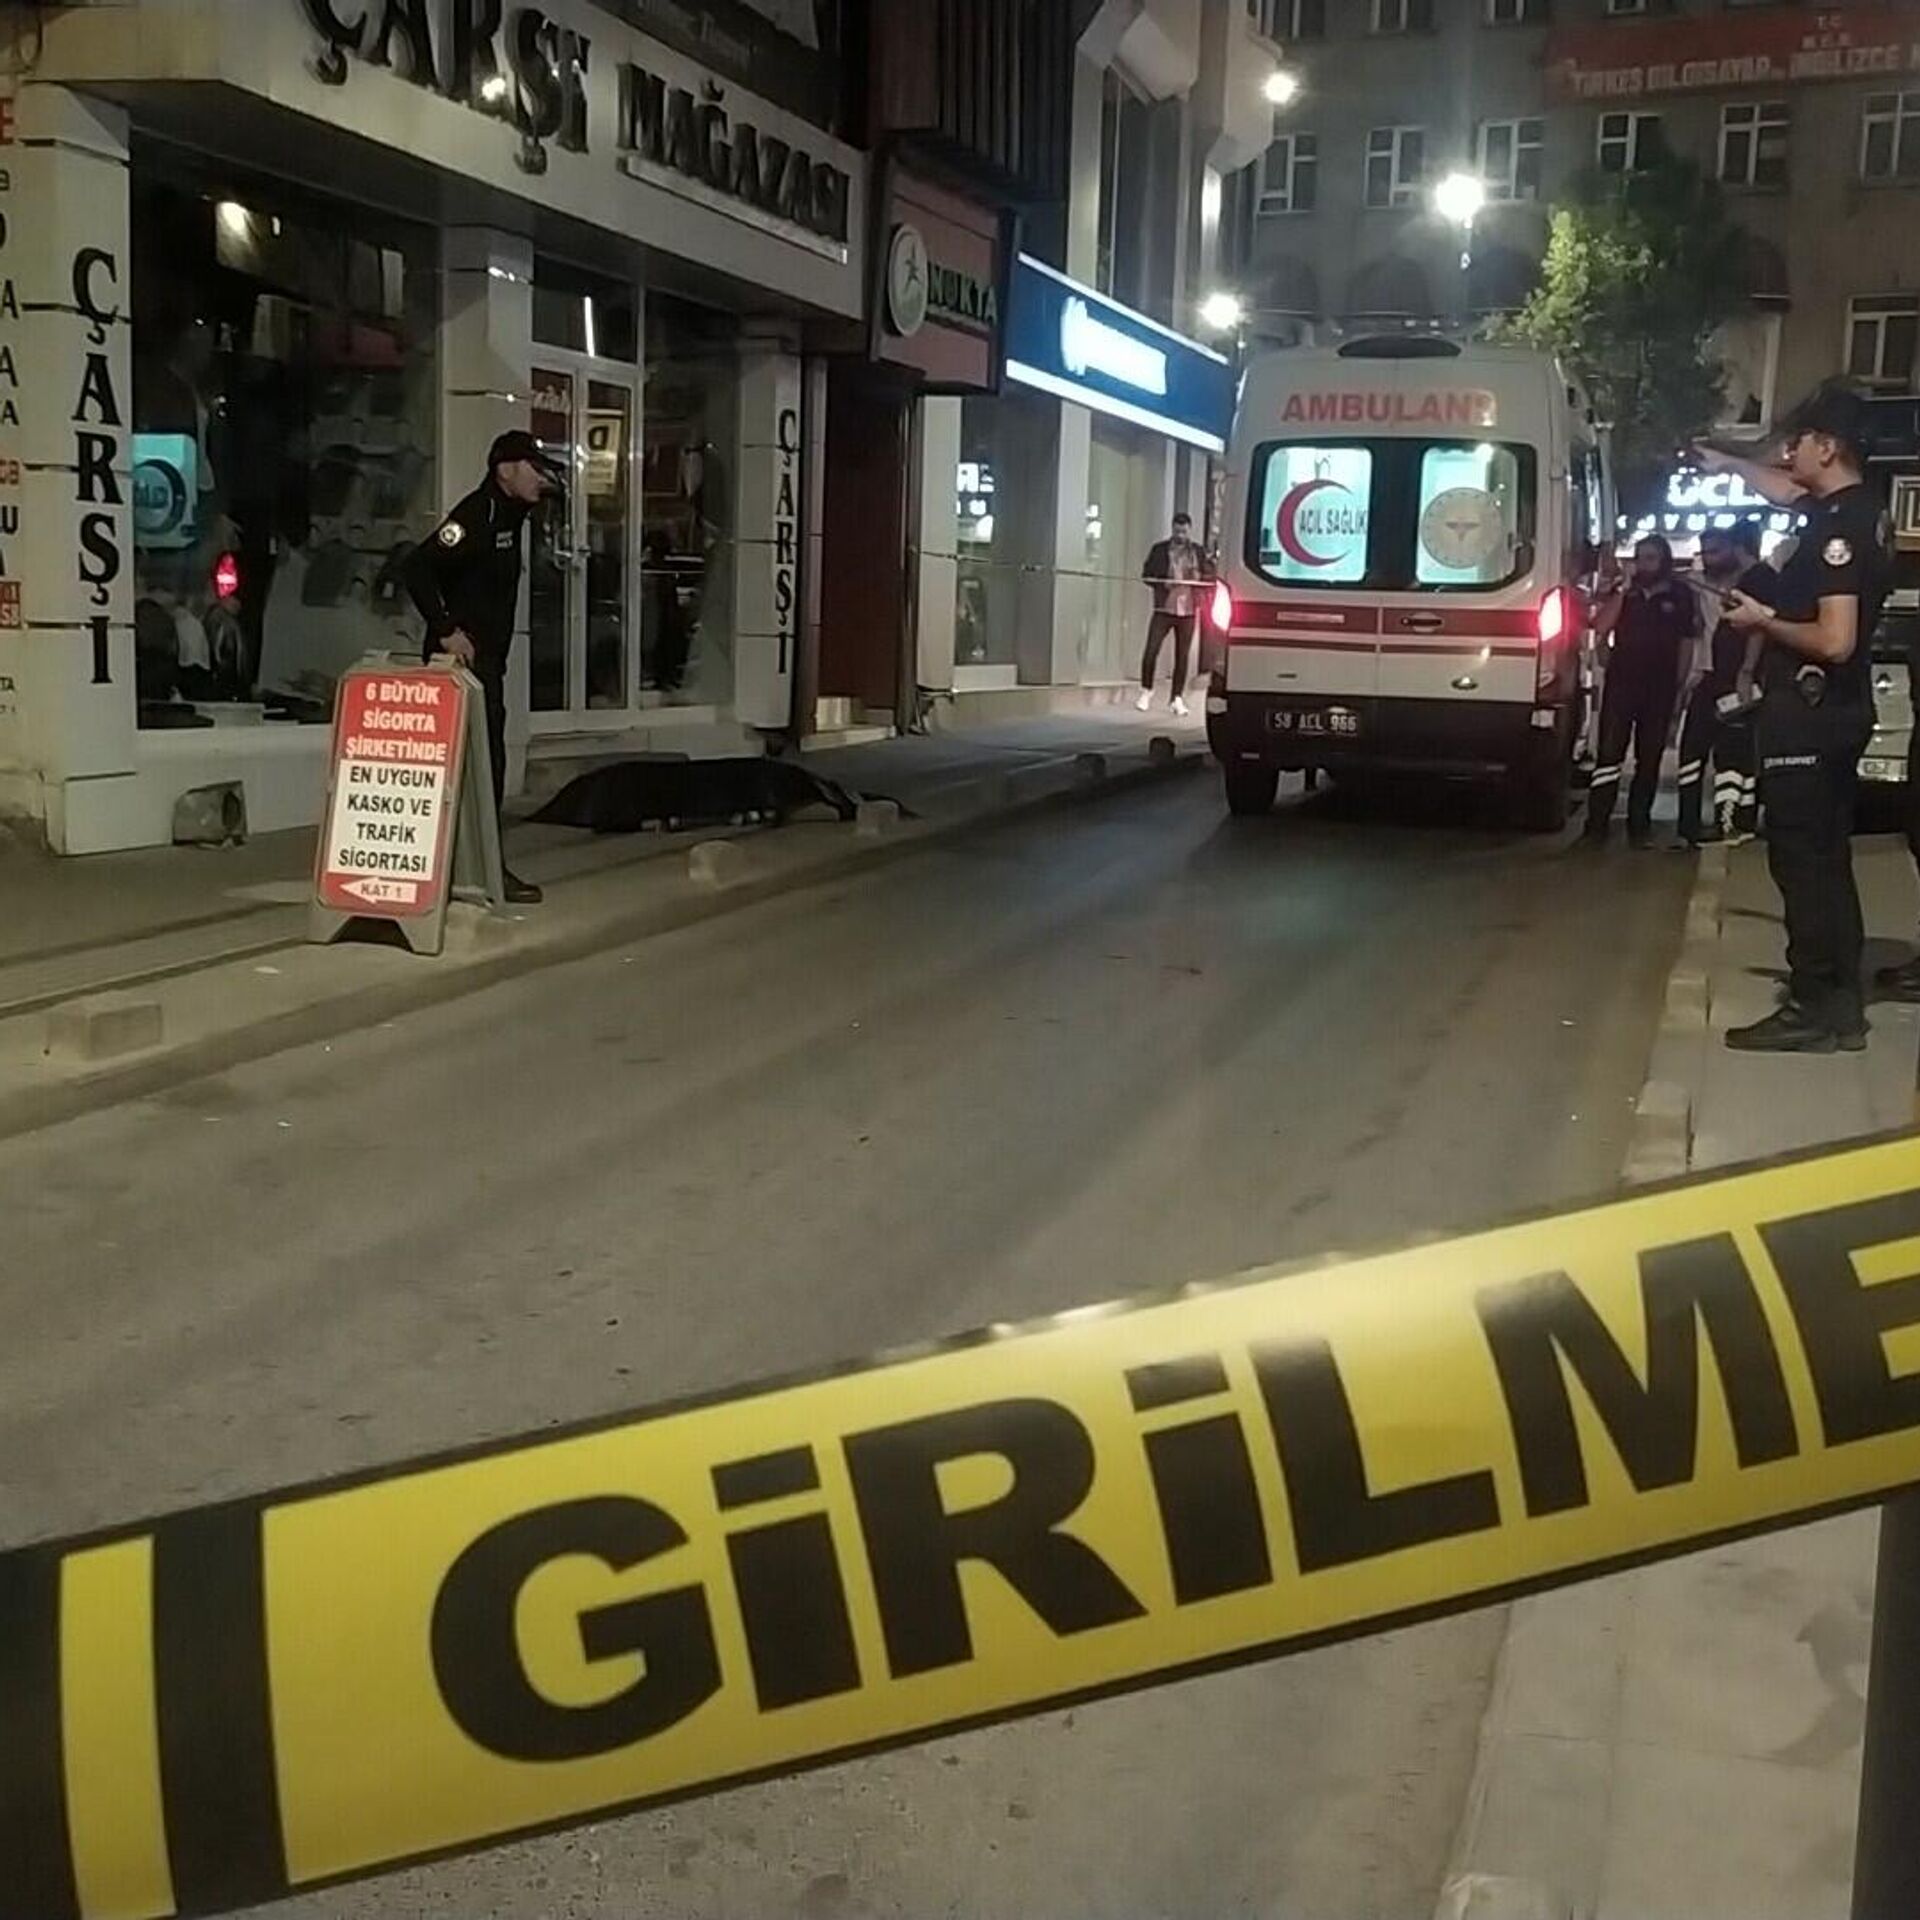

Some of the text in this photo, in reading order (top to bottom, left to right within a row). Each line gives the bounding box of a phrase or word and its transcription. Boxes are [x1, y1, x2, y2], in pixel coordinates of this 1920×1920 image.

[72, 247, 124, 684] ÇARŞI
[775, 409, 798, 674] ÇARŞI
[365, 682, 440, 705] 6 BÜYÜK
[363, 708, 436, 733] SİGORTA
[346, 736, 447, 761] ŞİRKETİNDE
[350, 766, 436, 788] EN UYGUN
[347, 793, 432, 816] KASKO VE
[357, 821, 417, 843] TRAFİK
[338, 848, 427, 873] SİGORTASI
